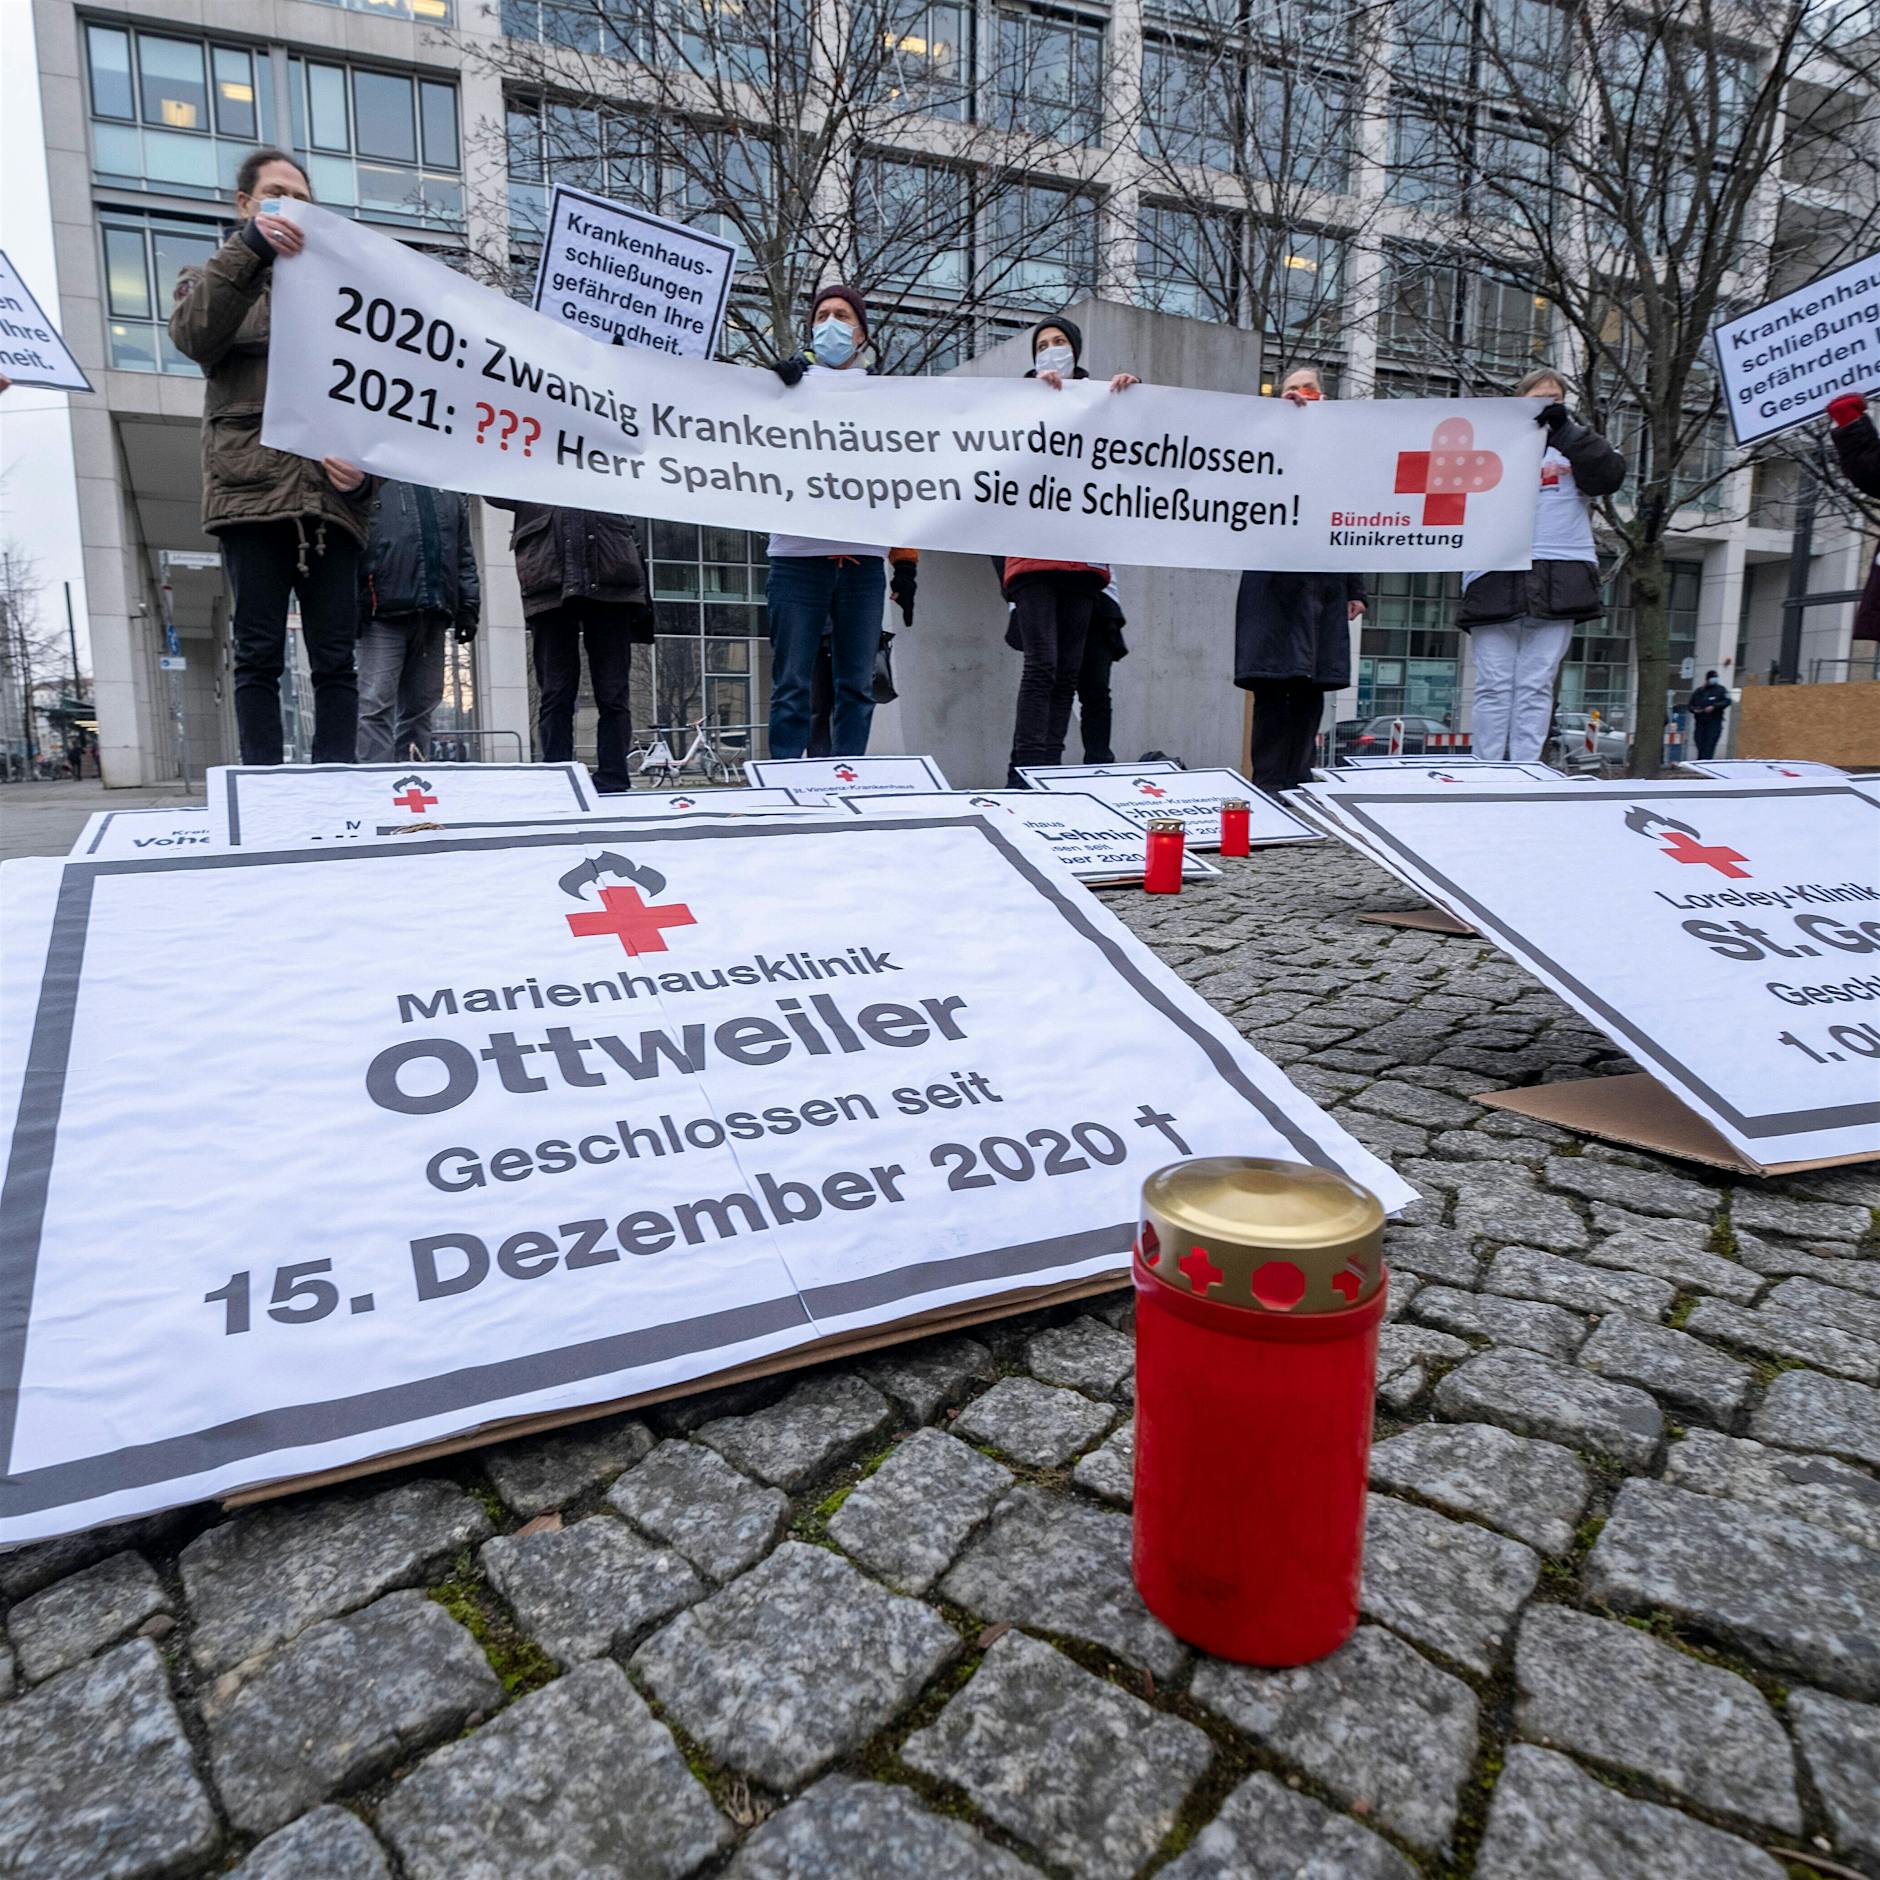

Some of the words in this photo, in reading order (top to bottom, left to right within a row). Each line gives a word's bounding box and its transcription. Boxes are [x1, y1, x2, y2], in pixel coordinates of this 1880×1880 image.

[567, 213, 713, 275] Krankenhaus-
[553, 273, 656, 319] gefährden
[664, 306, 704, 334] Ihre
[565, 247, 703, 304] schließungen
[0, 319, 51, 342] Ihre
[562, 301, 683, 356] Gesundheit.
[1742, 304, 1880, 373] schließung
[335, 286, 468, 367] 2020:
[482, 338, 639, 436] Zwanzig
[652, 403, 940, 453] Krankenhäuser
[953, 421, 1083, 459] wurden
[1091, 433, 1284, 475] geschlossen.
[1739, 339, 1867, 405] gefährden
[328, 359, 455, 434] 2021:
[475, 402, 542, 456] ???
[556, 430, 645, 479] Herr
[659, 457, 794, 501] Spahn,
[808, 472, 961, 509] stoppen
[974, 470, 1018, 507] Sie
[1028, 475, 1072, 512] die
[1081, 483, 1300, 531] Schließungen!
[1330, 530, 1464, 549] Klinikrettung
[1331, 511, 1411, 527] Bündnis
[1034, 829, 1144, 841] Lehnin
[1097, 853, 1146, 862] 2020
[397, 946, 904, 1023] Marienhausklinik
[1765, 976, 1880, 1006] Gesch
[365, 994, 967, 1116] Ottweiler
[426, 1089, 879, 1192] Geschlossen
[896, 1069, 1003, 1112] seit
[204, 1258, 375, 1336] 15.
[410, 1159, 905, 1302] Dezember
[929, 1122, 1128, 1191] 2020
